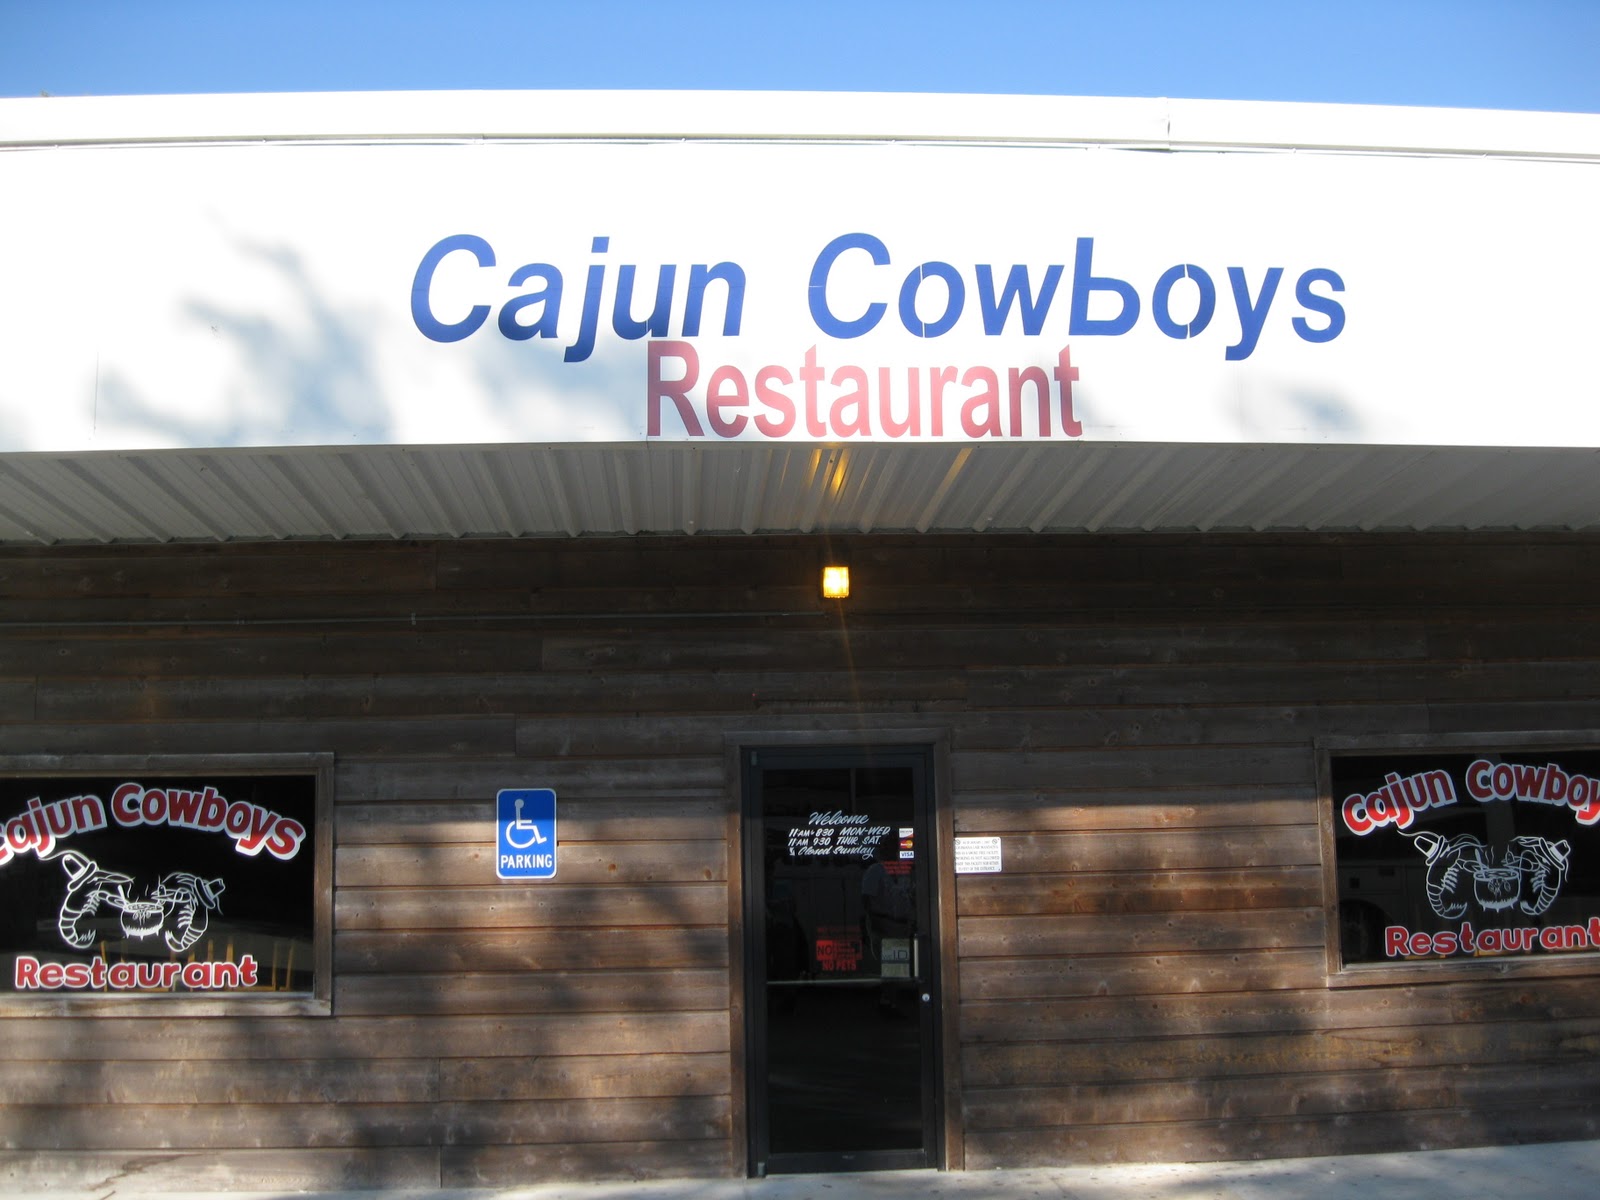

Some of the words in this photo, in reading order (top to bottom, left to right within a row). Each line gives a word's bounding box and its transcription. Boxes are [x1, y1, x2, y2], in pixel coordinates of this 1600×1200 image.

[410, 234, 747, 362] Cajun
[808, 232, 1347, 361] Cowboys
[647, 341, 1083, 438] Restaurant
[111, 782, 306, 860] Cowboys
[808, 810, 870, 826] Welcome
[1342, 769, 1457, 835] Cajun
[500, 854, 553, 869] PARKING
[797, 846, 833, 856] Closed
[832, 845, 875, 860] Sunday
[1384, 917, 1600, 958] Restaurant
[15, 954, 258, 989] Restaurant
